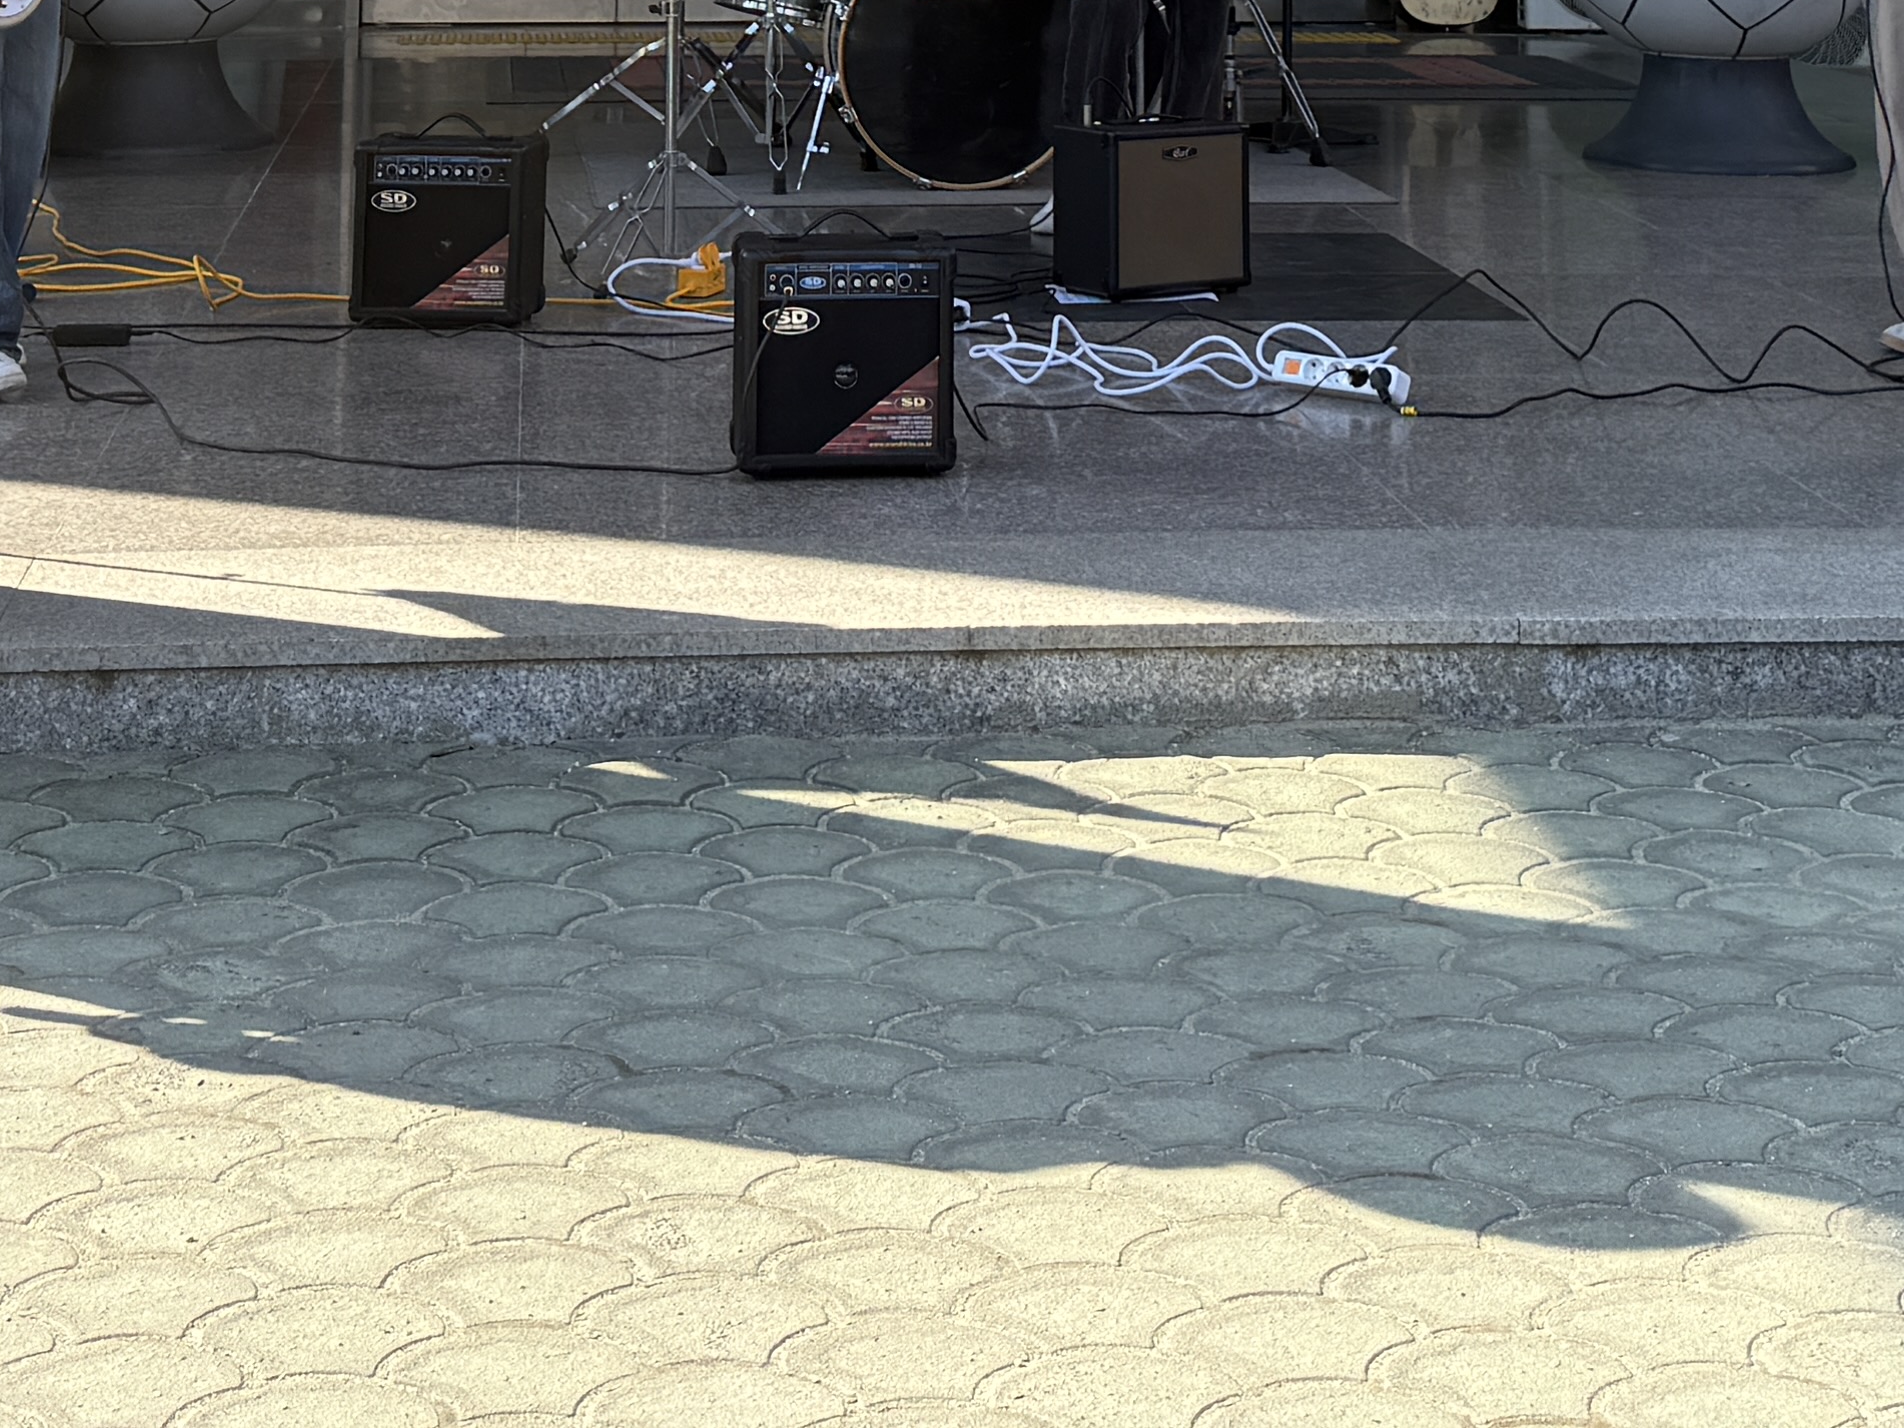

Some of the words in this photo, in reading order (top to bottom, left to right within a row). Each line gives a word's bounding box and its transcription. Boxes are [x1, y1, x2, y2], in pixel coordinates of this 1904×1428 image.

[380, 192, 408, 204] SD
[775, 310, 809, 325] SD
[901, 396, 927, 408] SD
